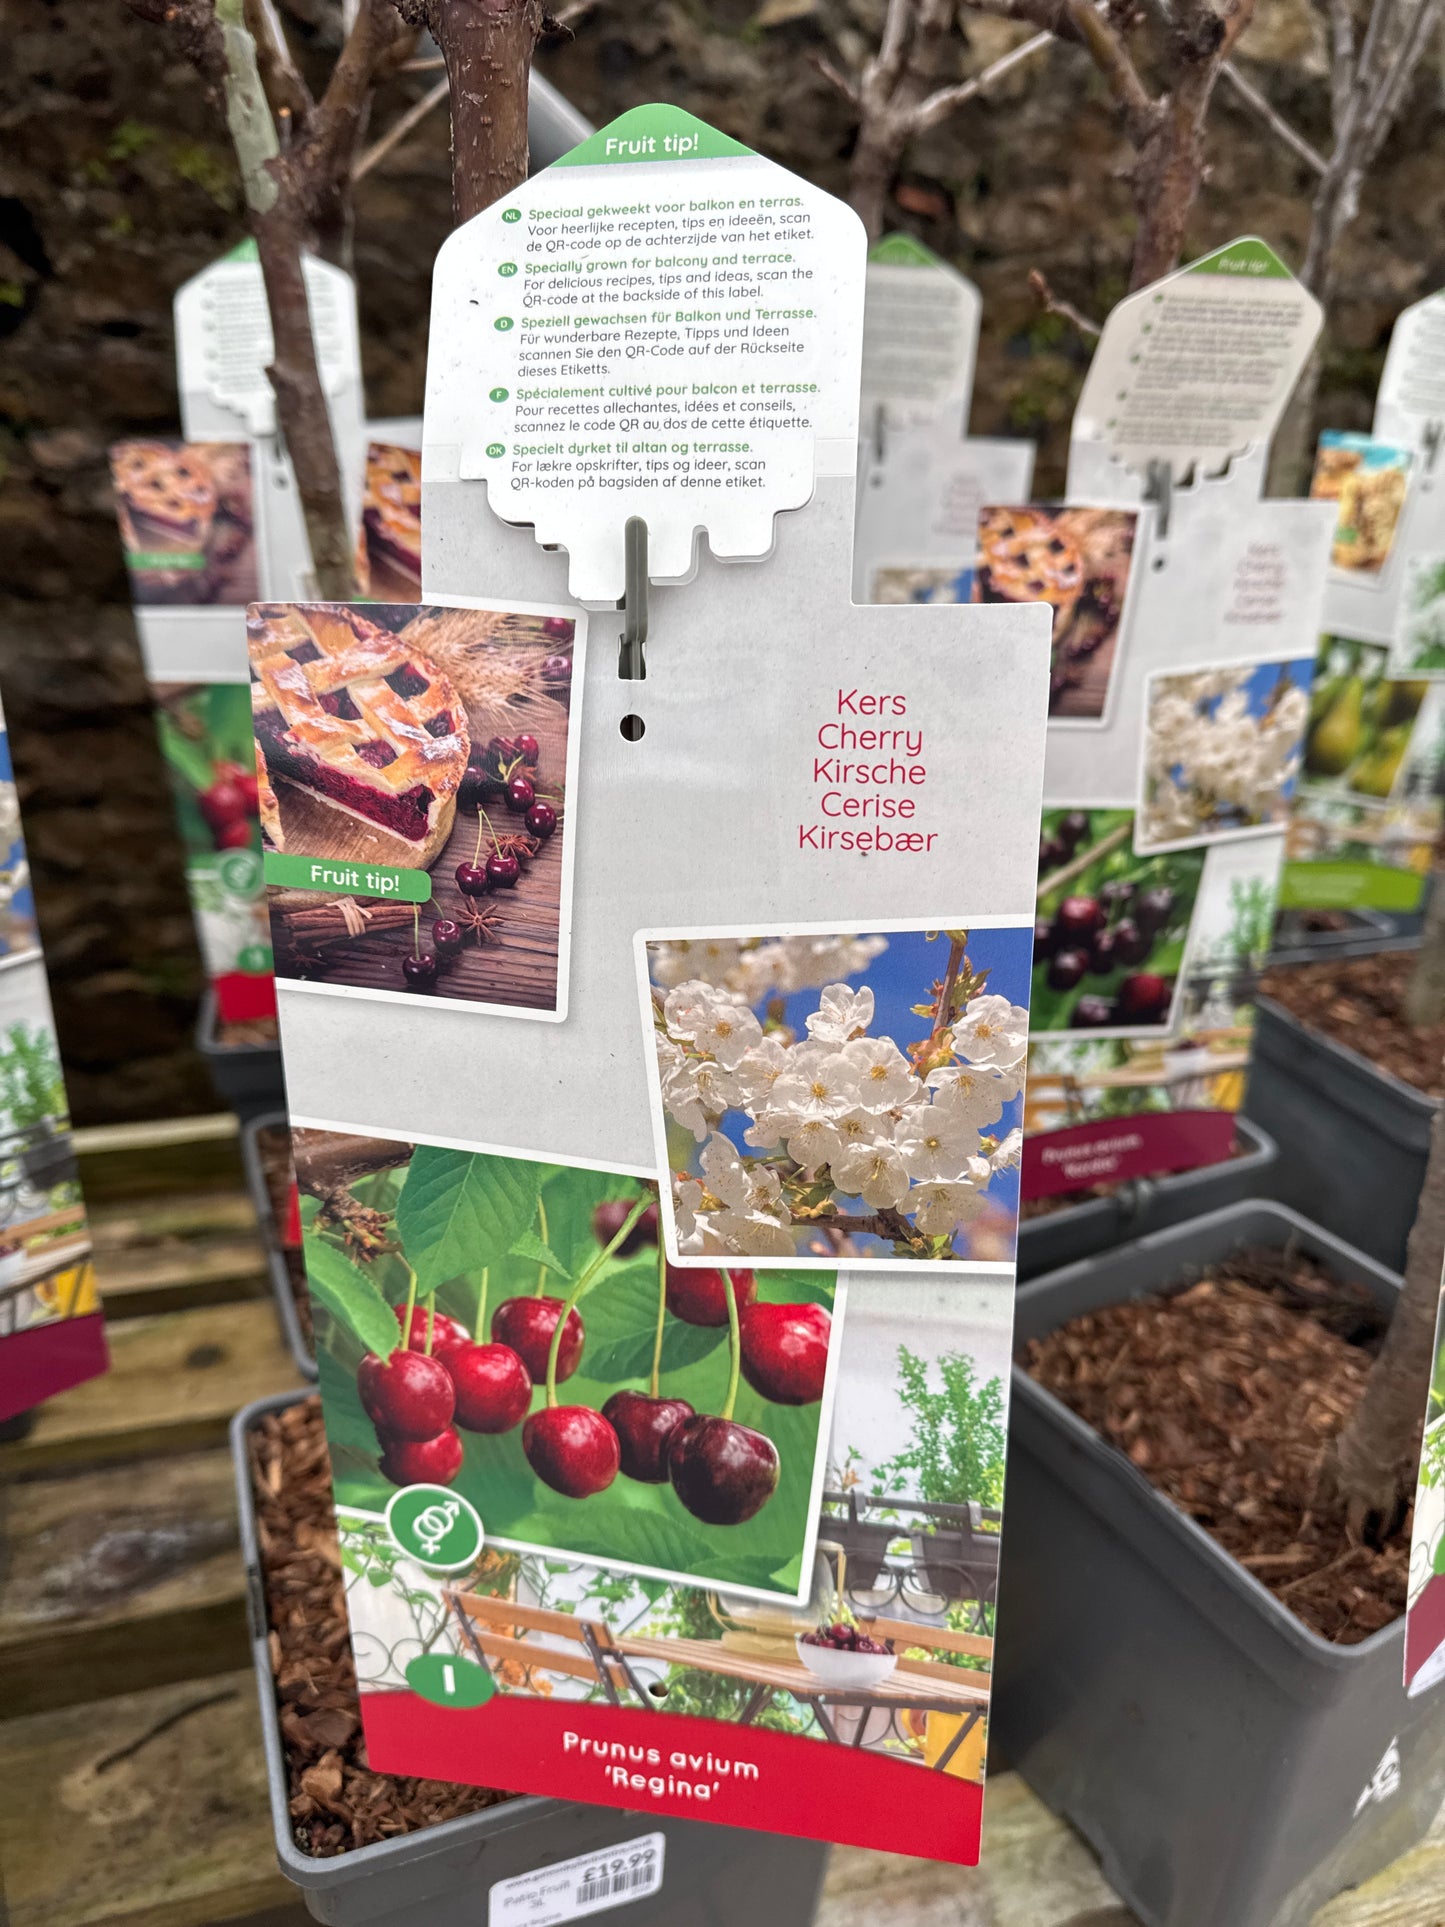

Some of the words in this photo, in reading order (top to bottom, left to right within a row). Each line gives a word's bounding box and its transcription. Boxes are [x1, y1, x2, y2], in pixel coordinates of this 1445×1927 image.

[606, 135, 656, 156] Fruit
[663, 133, 699, 156] tip!
[528, 207, 584, 222] Speciaal
[587, 204, 651, 219] gekweekt
[654, 204, 686, 212] voor
[689, 200, 735, 211] balkon
[738, 200, 755, 208] en
[759, 198, 804, 207] terras.
[527, 226, 559, 236] Voor
[561, 222, 615, 235] heerlijke
[618, 220, 678, 232] recepten,
[681, 218, 705, 230] tips
[708, 218, 725, 226] en
[728, 214, 776, 225] ideeën,
[779, 215, 811, 223] scan
[526, 241, 543, 252] de
[545, 238, 602, 253] QR-code
[605, 240, 622, 250] op
[625, 236, 642, 246] de
[645, 232, 717, 246] achterzijde
[721, 234, 745, 242] van
[749, 230, 771, 241] het
[773, 229, 814, 240] etiket.
[525, 261, 583, 276] Specially
[585, 261, 627, 273] grown
[631, 258, 652, 268] for
[655, 256, 708, 268] balcony
[711, 254, 738, 265] and
[741, 254, 796, 264] terrace.
[523, 280, 545, 290] For
[547, 278, 603, 289] delicious
[606, 276, 655, 287] recipes,
[659, 274, 682, 286] tips
[685, 272, 711, 283] and
[714, 271, 753, 282] ideas,
[756, 272, 788, 280] scan
[791, 268, 813, 279] the
[522, 295, 579, 308] QR-code
[581, 294, 595, 303] at
[598, 292, 619, 302] the
[623, 289, 681, 301] backside
[683, 288, 699, 299] of
[701, 288, 725, 298] this
[728, 286, 764, 297] label.
[521, 316, 571, 330] Speziell
[573, 314, 647, 328] gewachsen
[651, 312, 672, 322] für
[675, 310, 721, 322] Balkon
[725, 309, 751, 320] und
[755, 309, 817, 319] Terrasse.
[520, 334, 541, 344] Für
[543, 331, 621, 343] wunderbare
[624, 330, 681, 342] Rezepte,
[684, 328, 720, 340] Tipps
[723, 326, 749, 337] und
[752, 325, 790, 336] Ideen
[519, 351, 572, 360] scannen
[575, 348, 594, 358] Sie
[597, 347, 622, 358] den
[625, 344, 685, 359] QR-Code
[688, 344, 711, 355] auf
[713, 343, 737, 354] der
[740, 342, 805, 353] Rückseite
[517, 366, 557, 377] dieses
[560, 364, 611, 375] Etiketts.
[516, 387, 605, 401] Spécialement
[608, 384, 653, 396] cultivé
[655, 386, 689, 398] pour
[691, 383, 738, 394] balcon
[741, 384, 756, 394] et
[759, 384, 821, 393] terrasse.
[515, 406, 545, 416] Pour
[547, 404, 600, 415] recettes
[603, 402, 681, 414] allechantes,
[684, 400, 719, 412] idées
[722, 402, 736, 411] et
[739, 399, 796, 412] conseils,
[514, 423, 566, 432] scannez
[569, 420, 581, 430] le
[583, 419, 616, 430] code
[619, 419, 640, 432] QR
[643, 421, 660, 429] au
[663, 418, 688, 429] dos
[690, 418, 708, 429] de
[711, 418, 746, 428] cette
[749, 417, 813, 430] étiquette.
[512, 444, 565, 457] Specielt
[567, 442, 612, 456] dyrket
[615, 442, 629, 453] til
[631, 442, 667, 453] altan
[671, 444, 689, 455] og
[693, 442, 753, 452] terrasse.
[511, 462, 533, 472] For
[536, 460, 573, 471] lækre
[575, 459, 642, 473] opskrifter,
[645, 460, 670, 472] tips
[672, 462, 691, 473] og
[694, 459, 731, 471] ideer,
[734, 461, 766, 470] scan
[510, 477, 575, 490] QR-koden
[577, 476, 595, 490] på
[599, 476, 659, 490] bagsiden
[662, 476, 677, 487] af
[680, 476, 722, 487] denne
[725, 476, 766, 487] etiket.
[838, 689, 906, 716] Kers
[818, 723, 923, 757] Cherry
[814, 758, 927, 785] Kirsche
[821, 791, 916, 819] Cerise
[799, 824, 938, 852] Kirsebær
[311, 864, 360, 887] Fruit
[365, 871, 400, 895] tip!
[563, 1731, 661, 1766] Prunus
[669, 1751, 760, 1781] avium
[584, 1848, 657, 1883] £19.99
